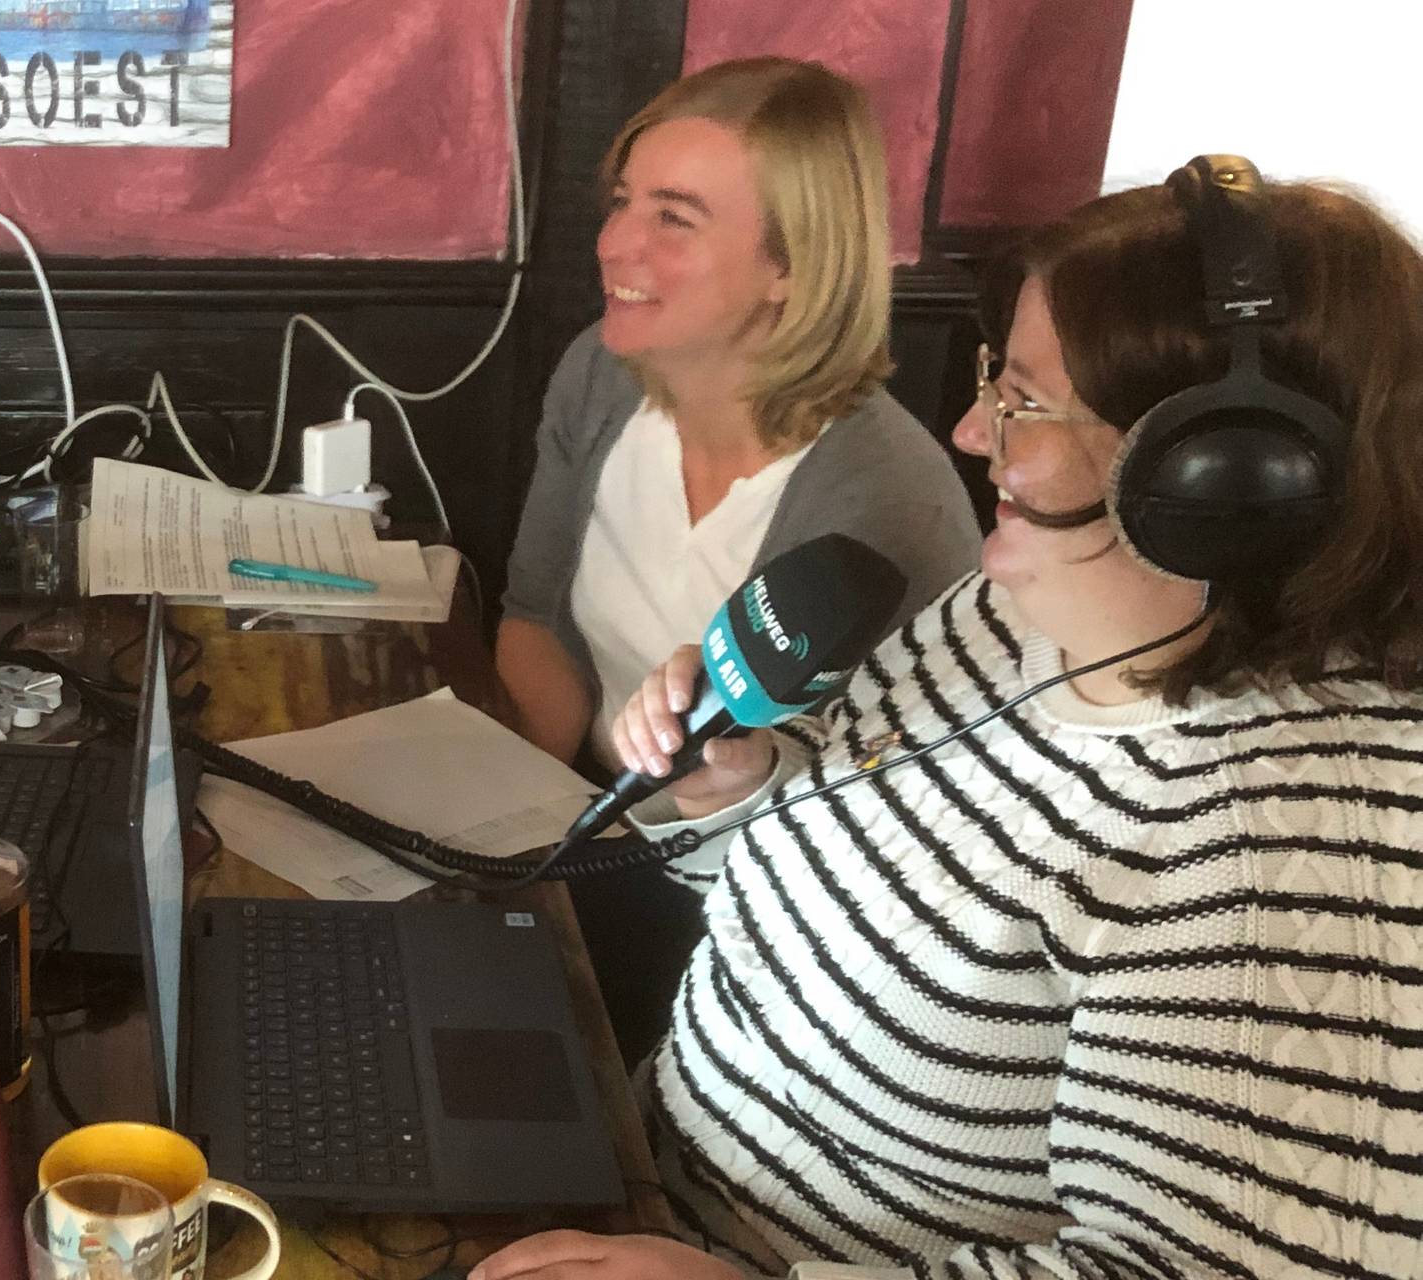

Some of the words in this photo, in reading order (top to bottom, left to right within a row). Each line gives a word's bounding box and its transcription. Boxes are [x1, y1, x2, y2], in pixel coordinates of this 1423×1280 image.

[752, 574, 791, 652] HELLWEG
[708, 627, 729, 661] ON
[718, 659, 748, 700] AIR
